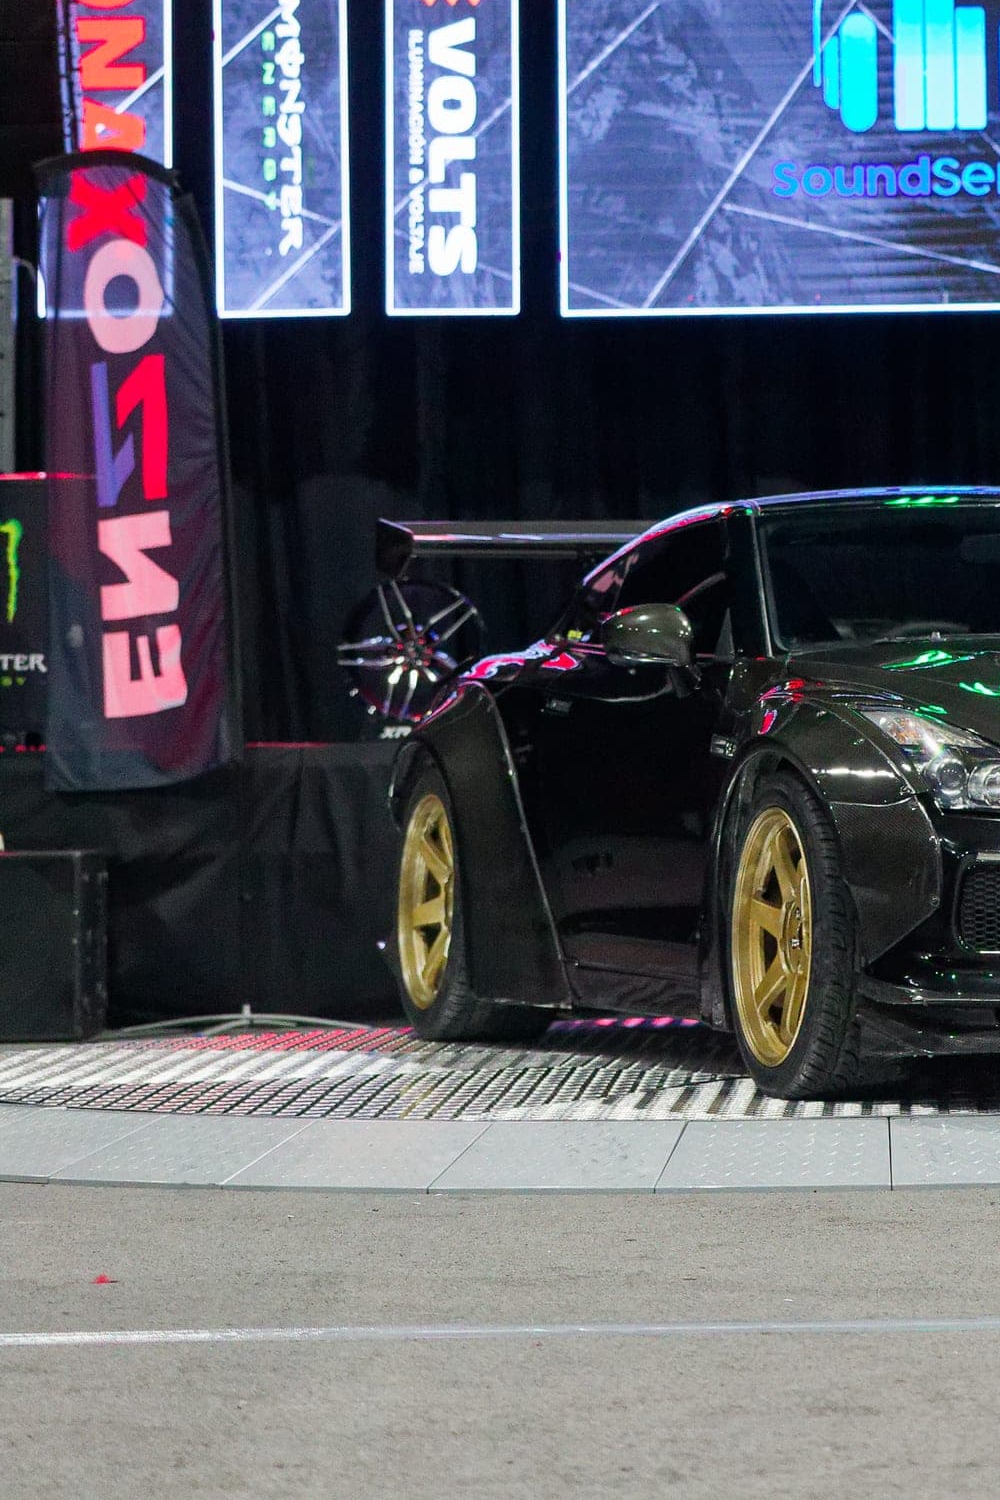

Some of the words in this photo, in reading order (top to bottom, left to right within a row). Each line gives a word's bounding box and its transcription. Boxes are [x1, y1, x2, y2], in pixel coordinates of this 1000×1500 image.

[261, 30, 277, 210] ENERGY
[408, 167, 424, 184] &
[426, 18, 478, 277] VOLTS
[407, 185, 424, 274] VOLTAJE
